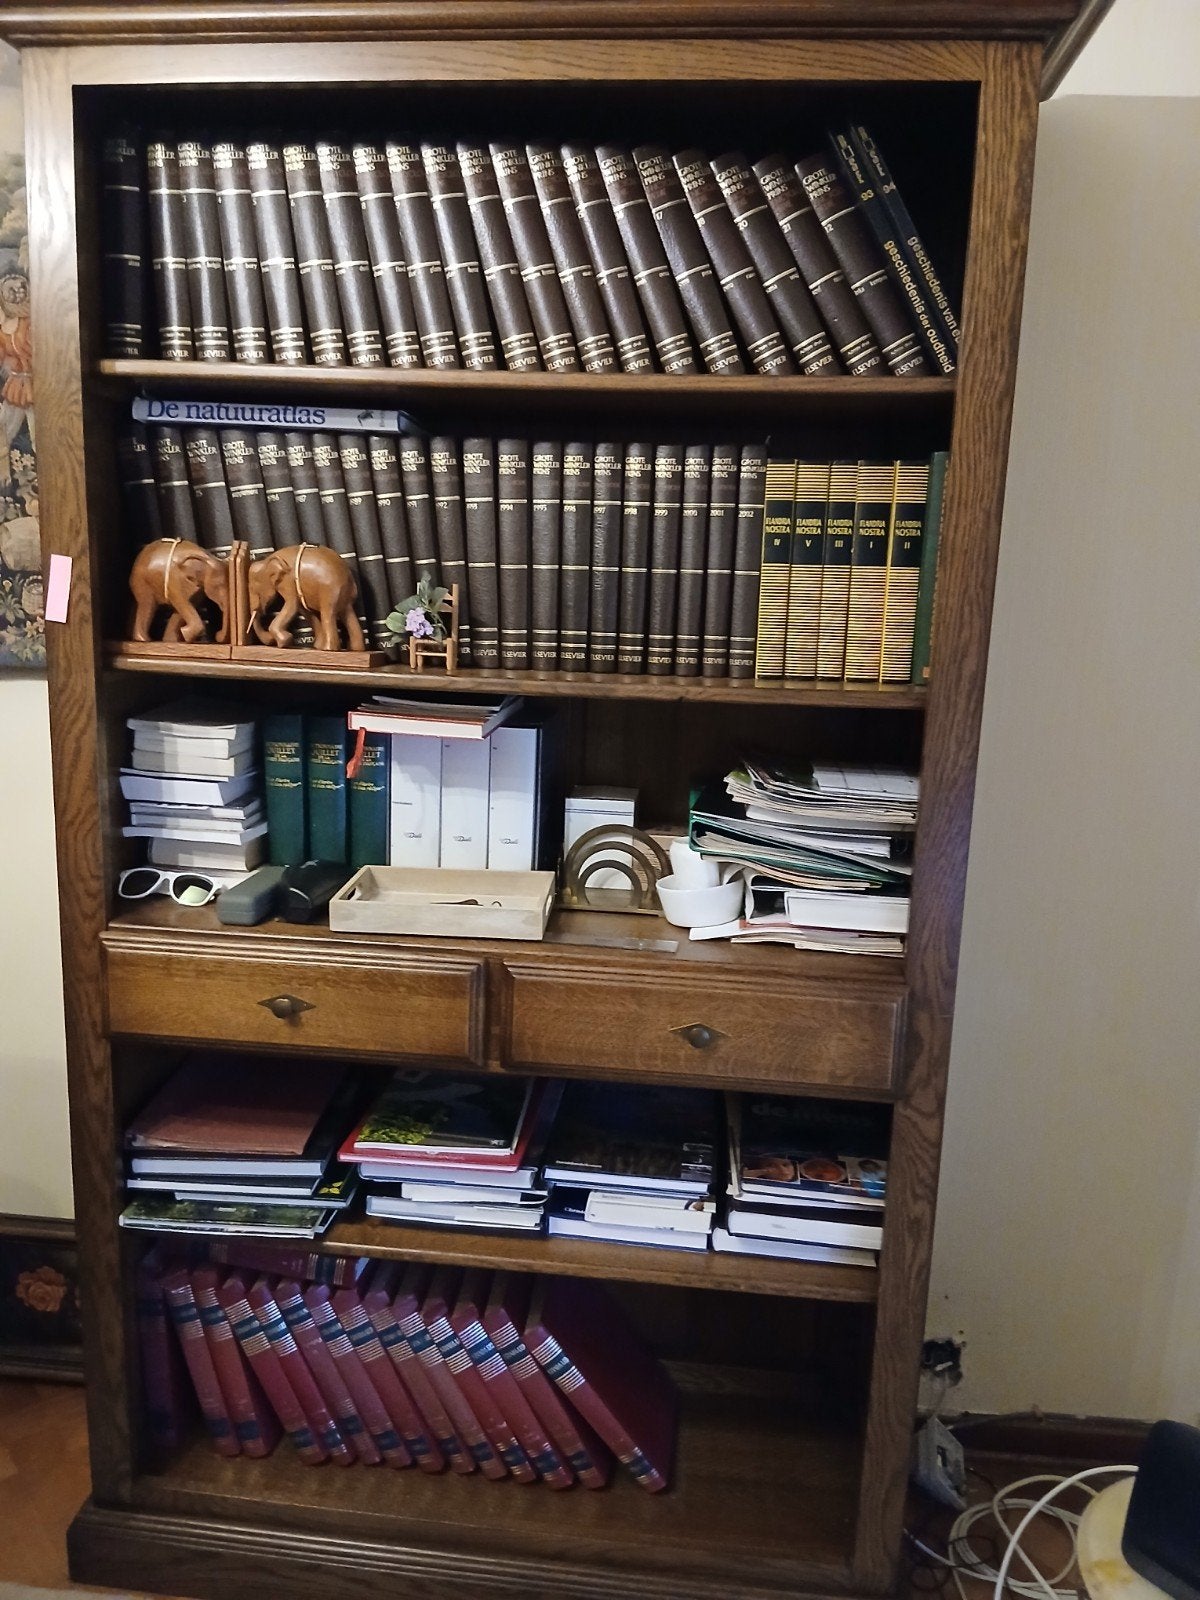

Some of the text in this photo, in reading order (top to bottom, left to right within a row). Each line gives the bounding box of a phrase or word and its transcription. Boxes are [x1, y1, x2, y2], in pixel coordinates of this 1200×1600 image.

[802, 169, 827, 184] GROTE
[861, 189, 874, 200] 93
[883, 182, 896, 193] 94
[908, 236, 947, 310] geschiedenis
[942, 308, 957, 329] van
[884, 241, 955, 373] geschiedenis der oudheid
[147, 400, 325, 424] De natuuratlas
[827, 527, 852, 535] NOSTRA
